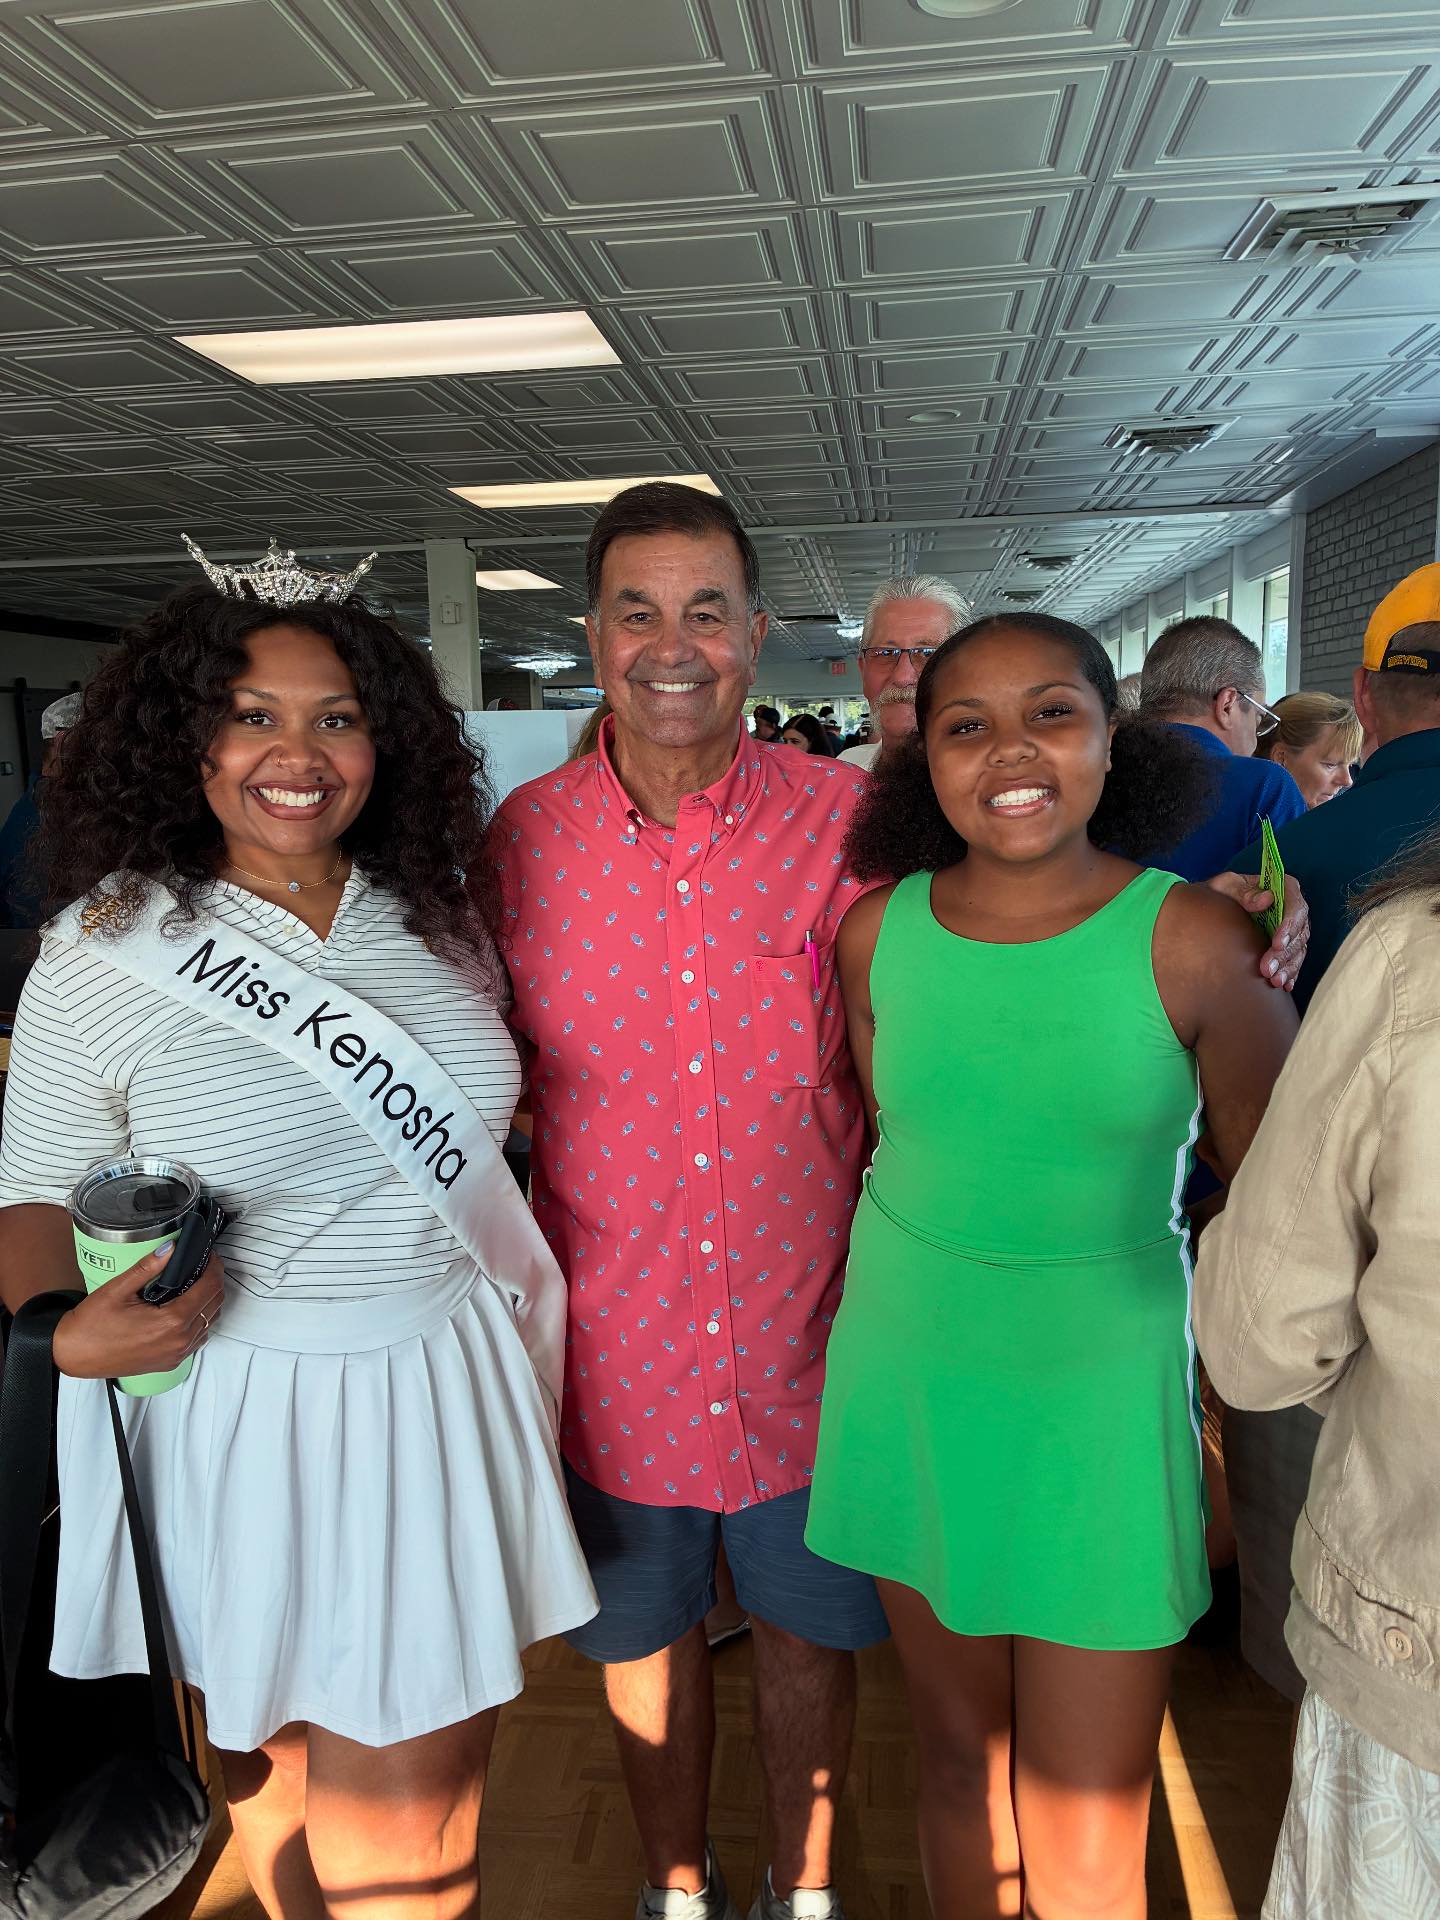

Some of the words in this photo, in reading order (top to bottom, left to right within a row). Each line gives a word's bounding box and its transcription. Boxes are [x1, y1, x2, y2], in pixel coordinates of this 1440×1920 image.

[176, 938, 290, 1019] Miss
[293, 1001, 468, 1190] Kenosha
[81, 1249, 111, 1268] YETI
